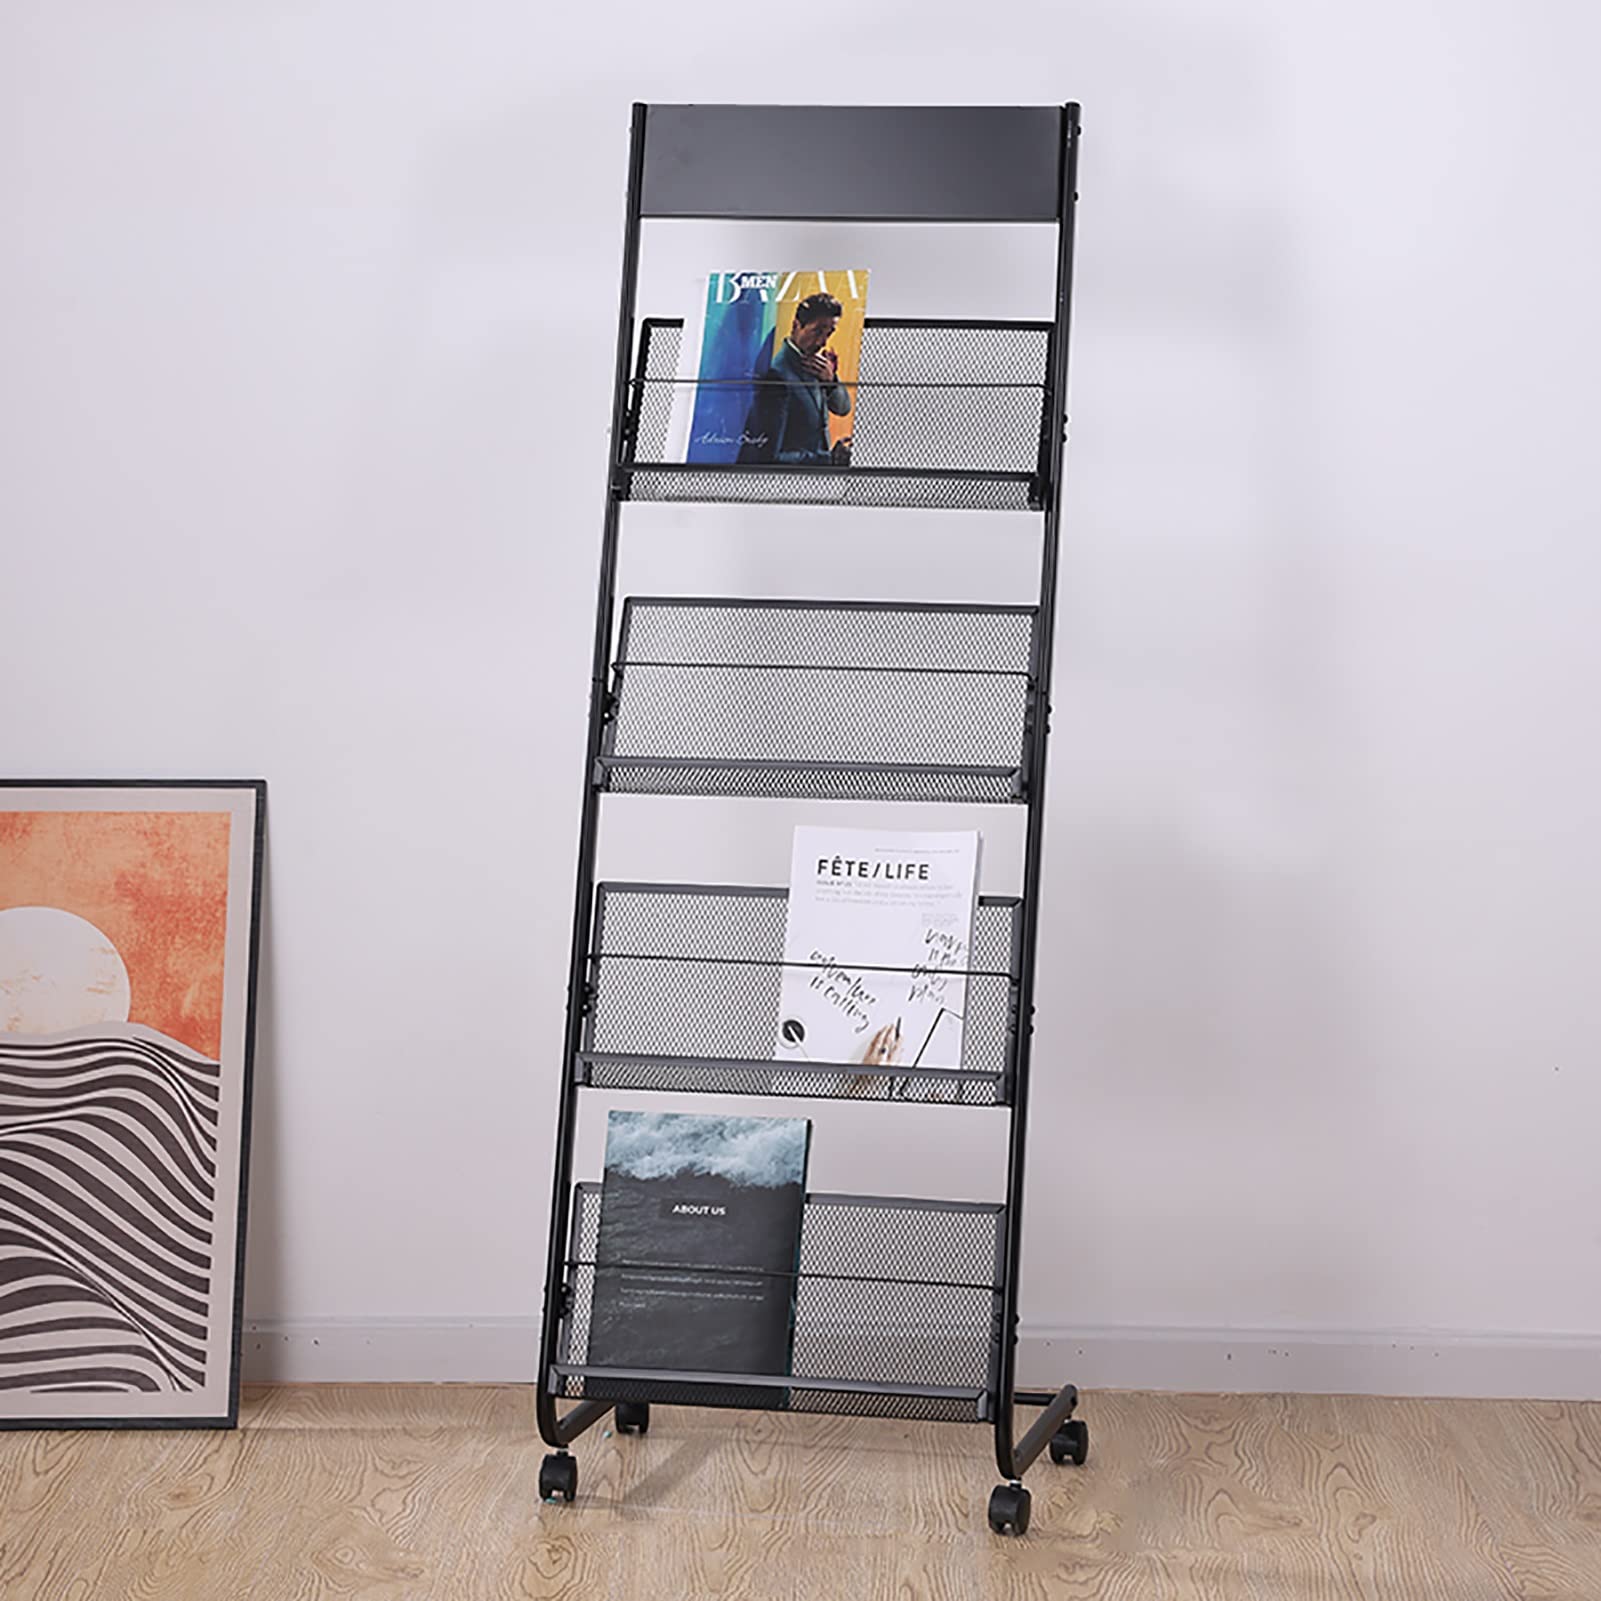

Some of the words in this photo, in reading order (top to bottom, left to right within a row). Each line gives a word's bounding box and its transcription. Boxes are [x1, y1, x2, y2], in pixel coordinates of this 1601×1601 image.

[741, 275, 778, 289] MEN
[816, 856, 930, 880] FÊTE/LIFE
[672, 1204, 710, 1216] ABOUT
[711, 1206, 726, 1216] US
